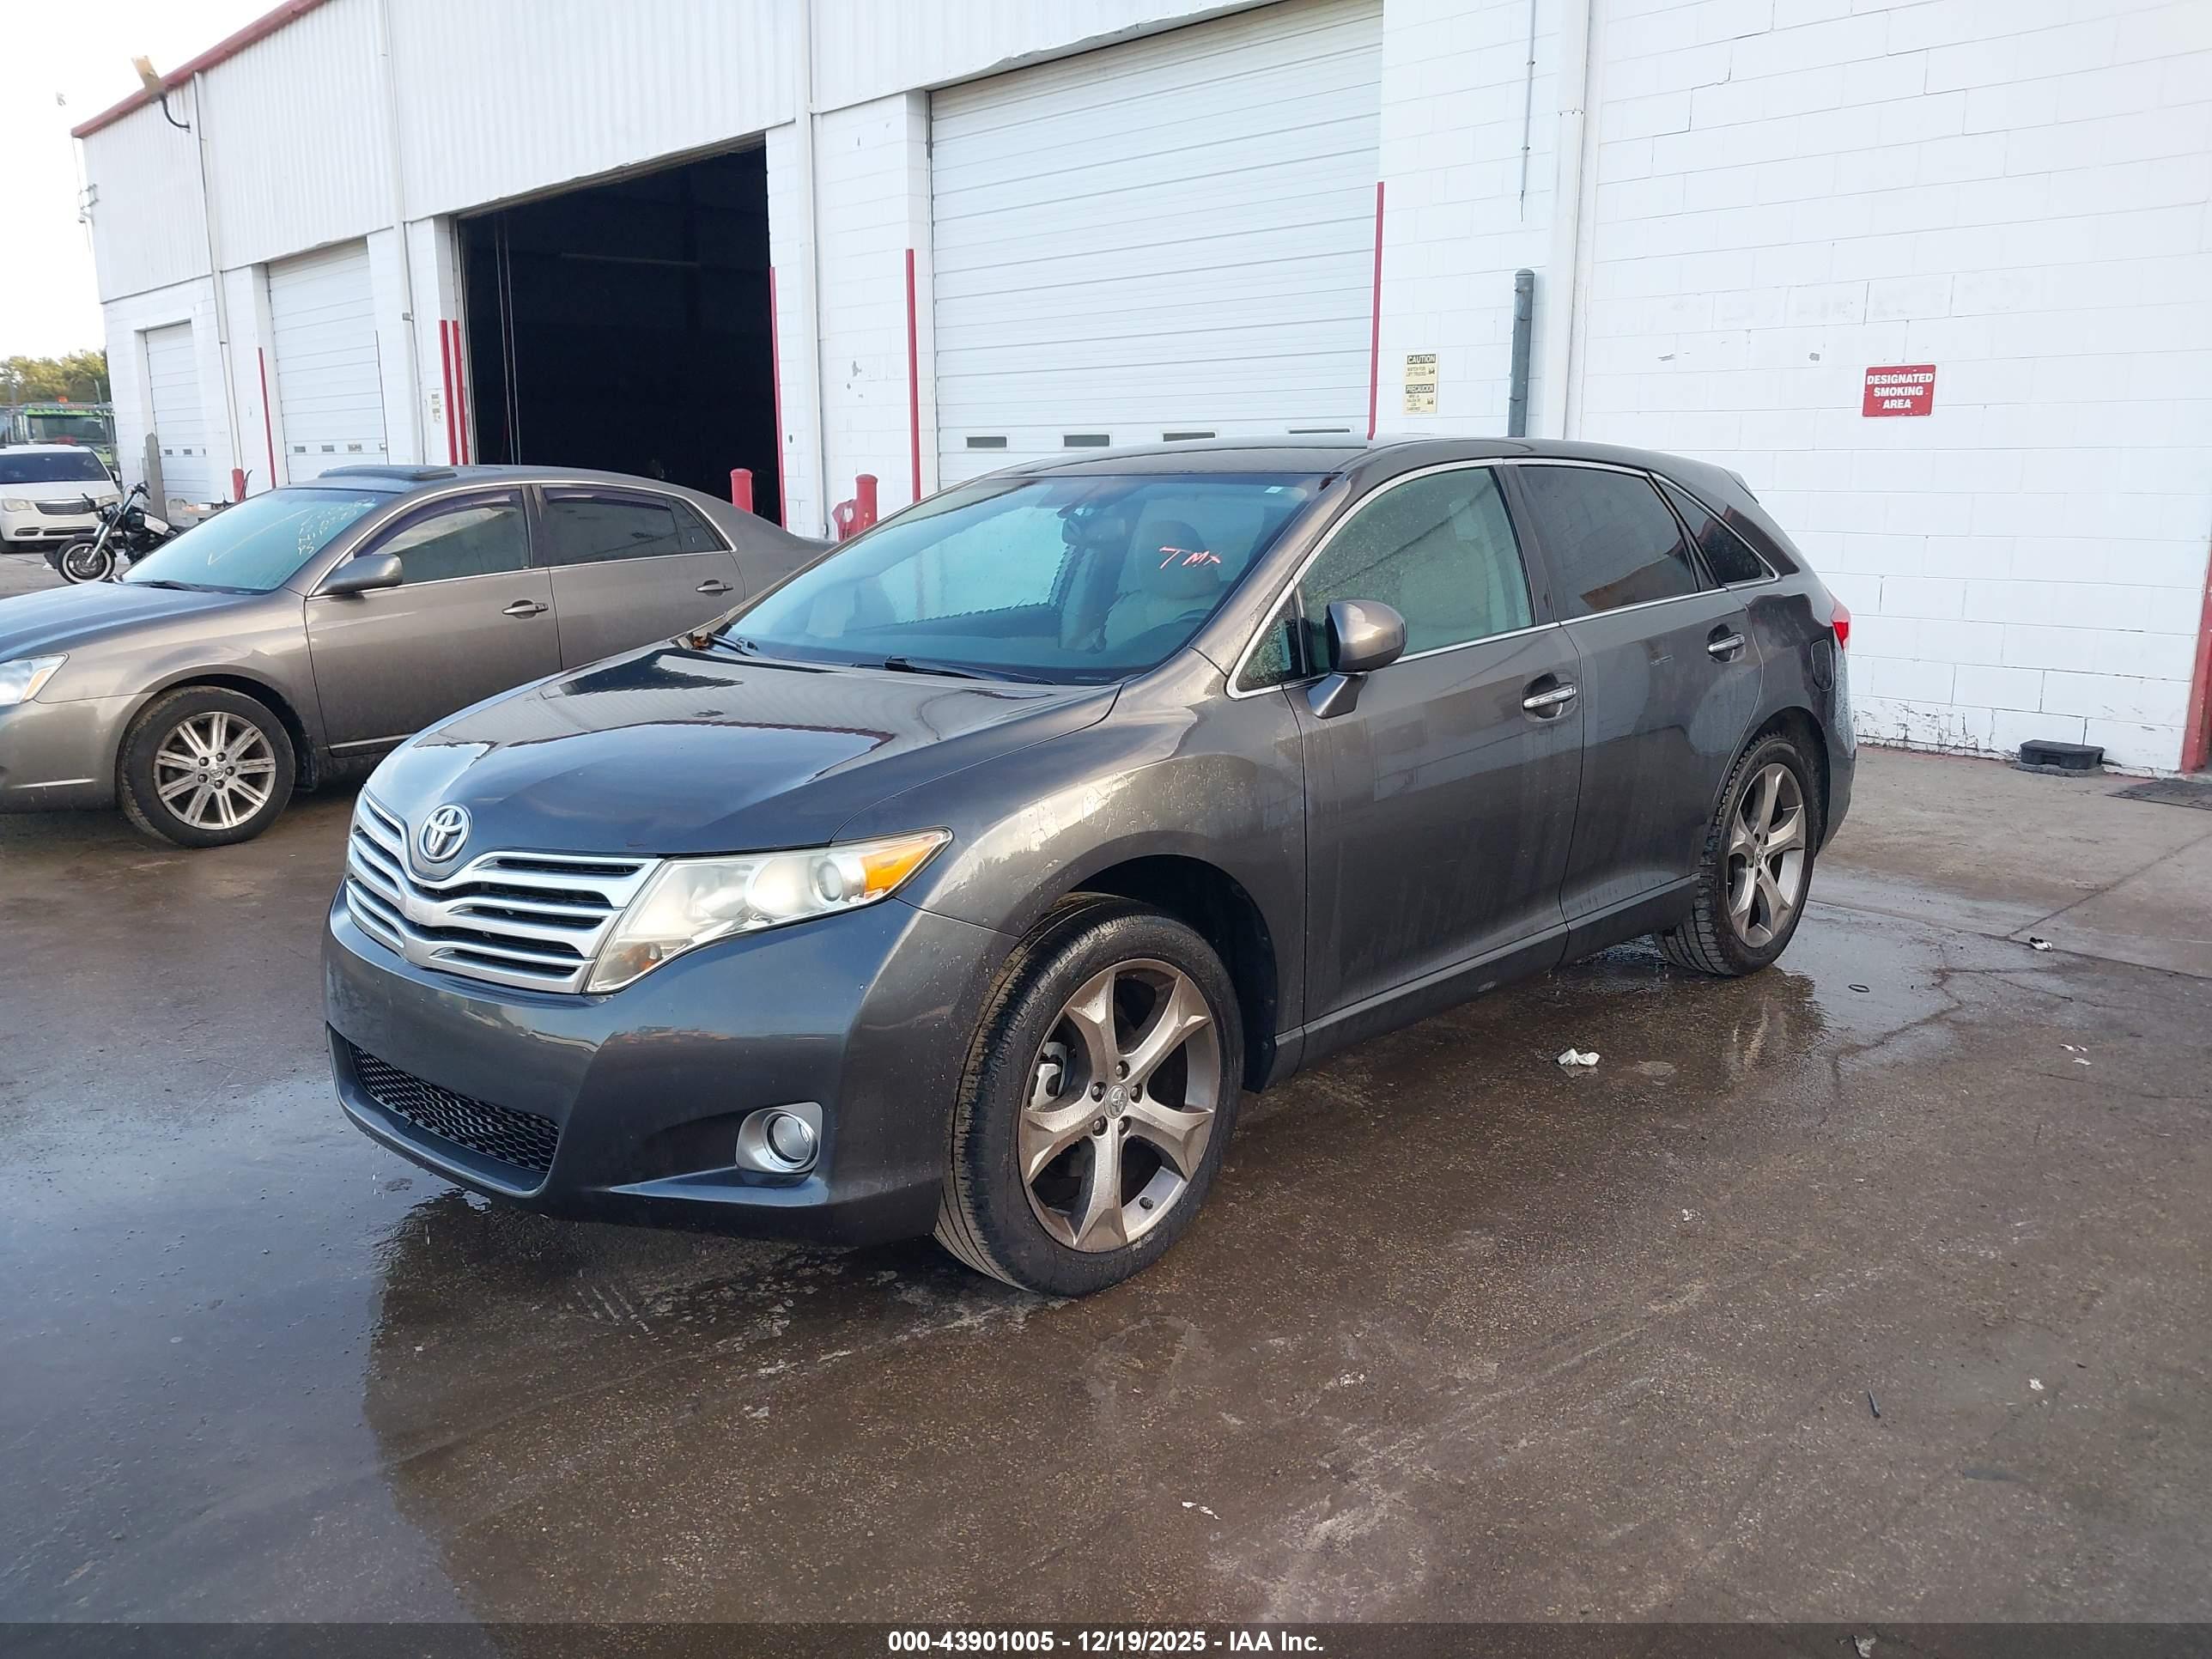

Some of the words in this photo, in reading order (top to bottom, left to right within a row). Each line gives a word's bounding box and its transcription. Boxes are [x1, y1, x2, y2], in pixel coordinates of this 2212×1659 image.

[1407, 354, 1436, 364] CAUTION
[1866, 373, 1934, 385] DESIGNATED
[1873, 386, 1923, 397] SMOKING
[1881, 398, 1911, 410] AREA
